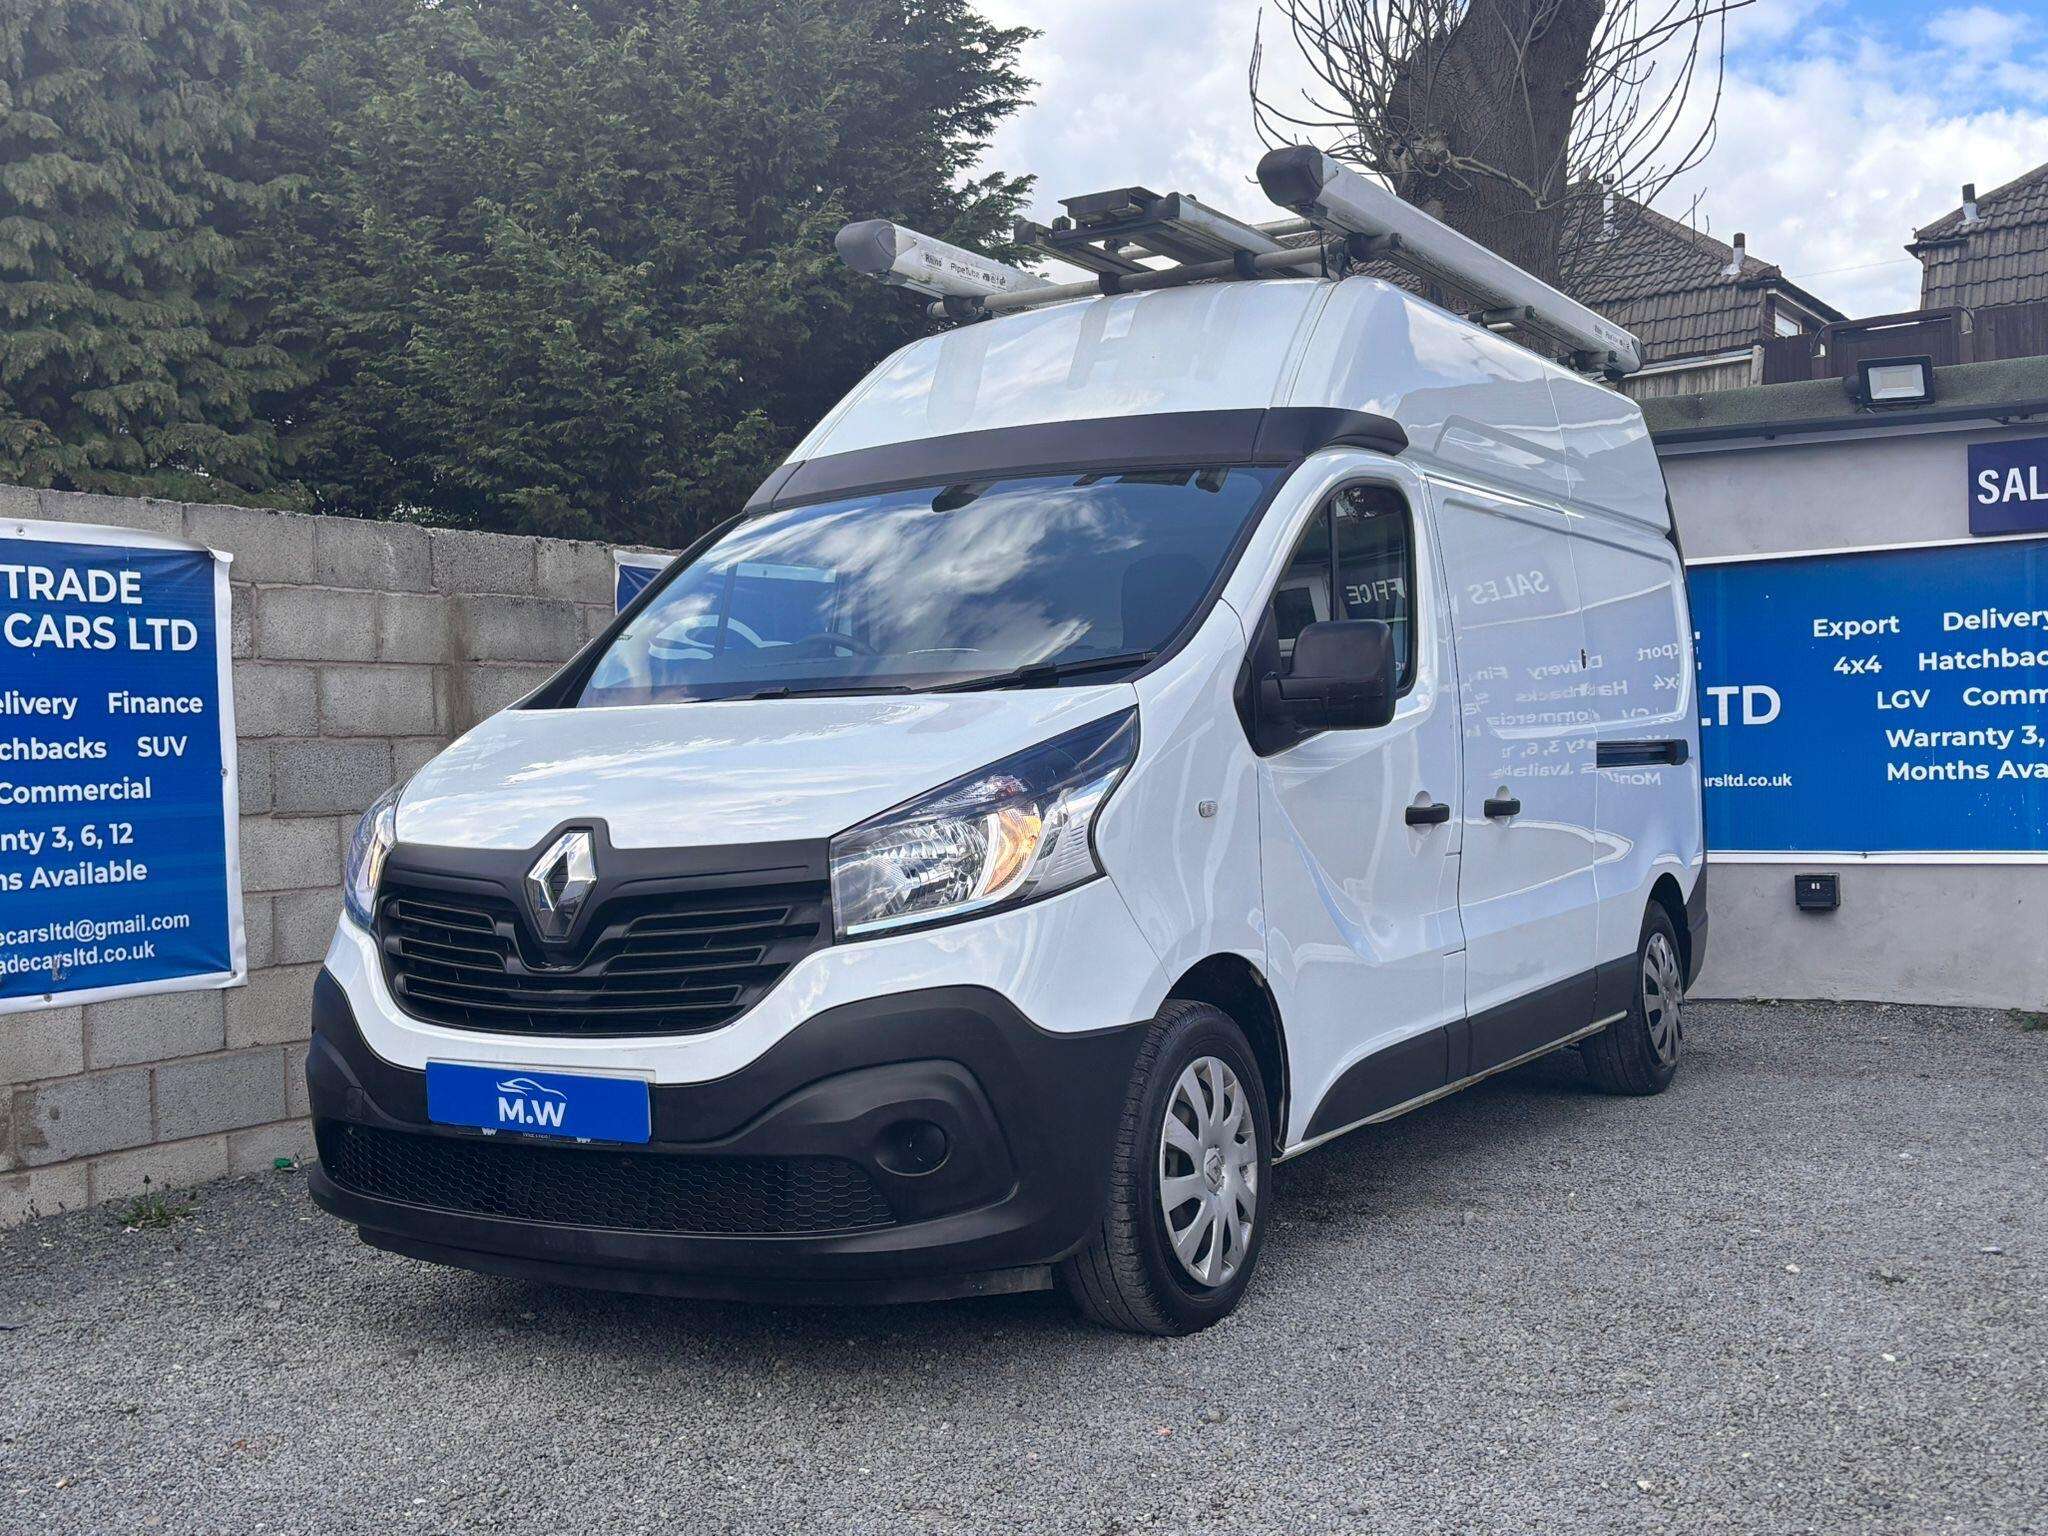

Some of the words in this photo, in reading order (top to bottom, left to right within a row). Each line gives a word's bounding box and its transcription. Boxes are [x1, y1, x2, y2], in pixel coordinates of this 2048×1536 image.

[1977, 466, 2048, 504] SAL
[0, 564, 143, 604] TRADE
[3, 612, 117, 649] CARS
[129, 617, 198, 651] LTD
[1812, 614, 1900, 641] Export
[1833, 654, 1882, 676] 4x4
[107, 690, 203, 714] Finance
[1876, 688, 1930, 710] LGV
[0, 736, 107, 760] chbacks
[137, 735, 188, 757] SUV
[1885, 727, 2014, 750] Warranty
[2021, 725, 2046, 748] 3,
[1704, 772, 1792, 788] rsltd.co.uk
[1887, 760, 1990, 782] Months
[0, 776, 151, 804] Commercial
[0, 828, 45, 855] nty
[51, 825, 74, 851] 3,
[80, 823, 103, 850] 6,
[109, 822, 134, 845] 12
[29, 859, 148, 889] Available
[497, 1096, 566, 1127] M.W
